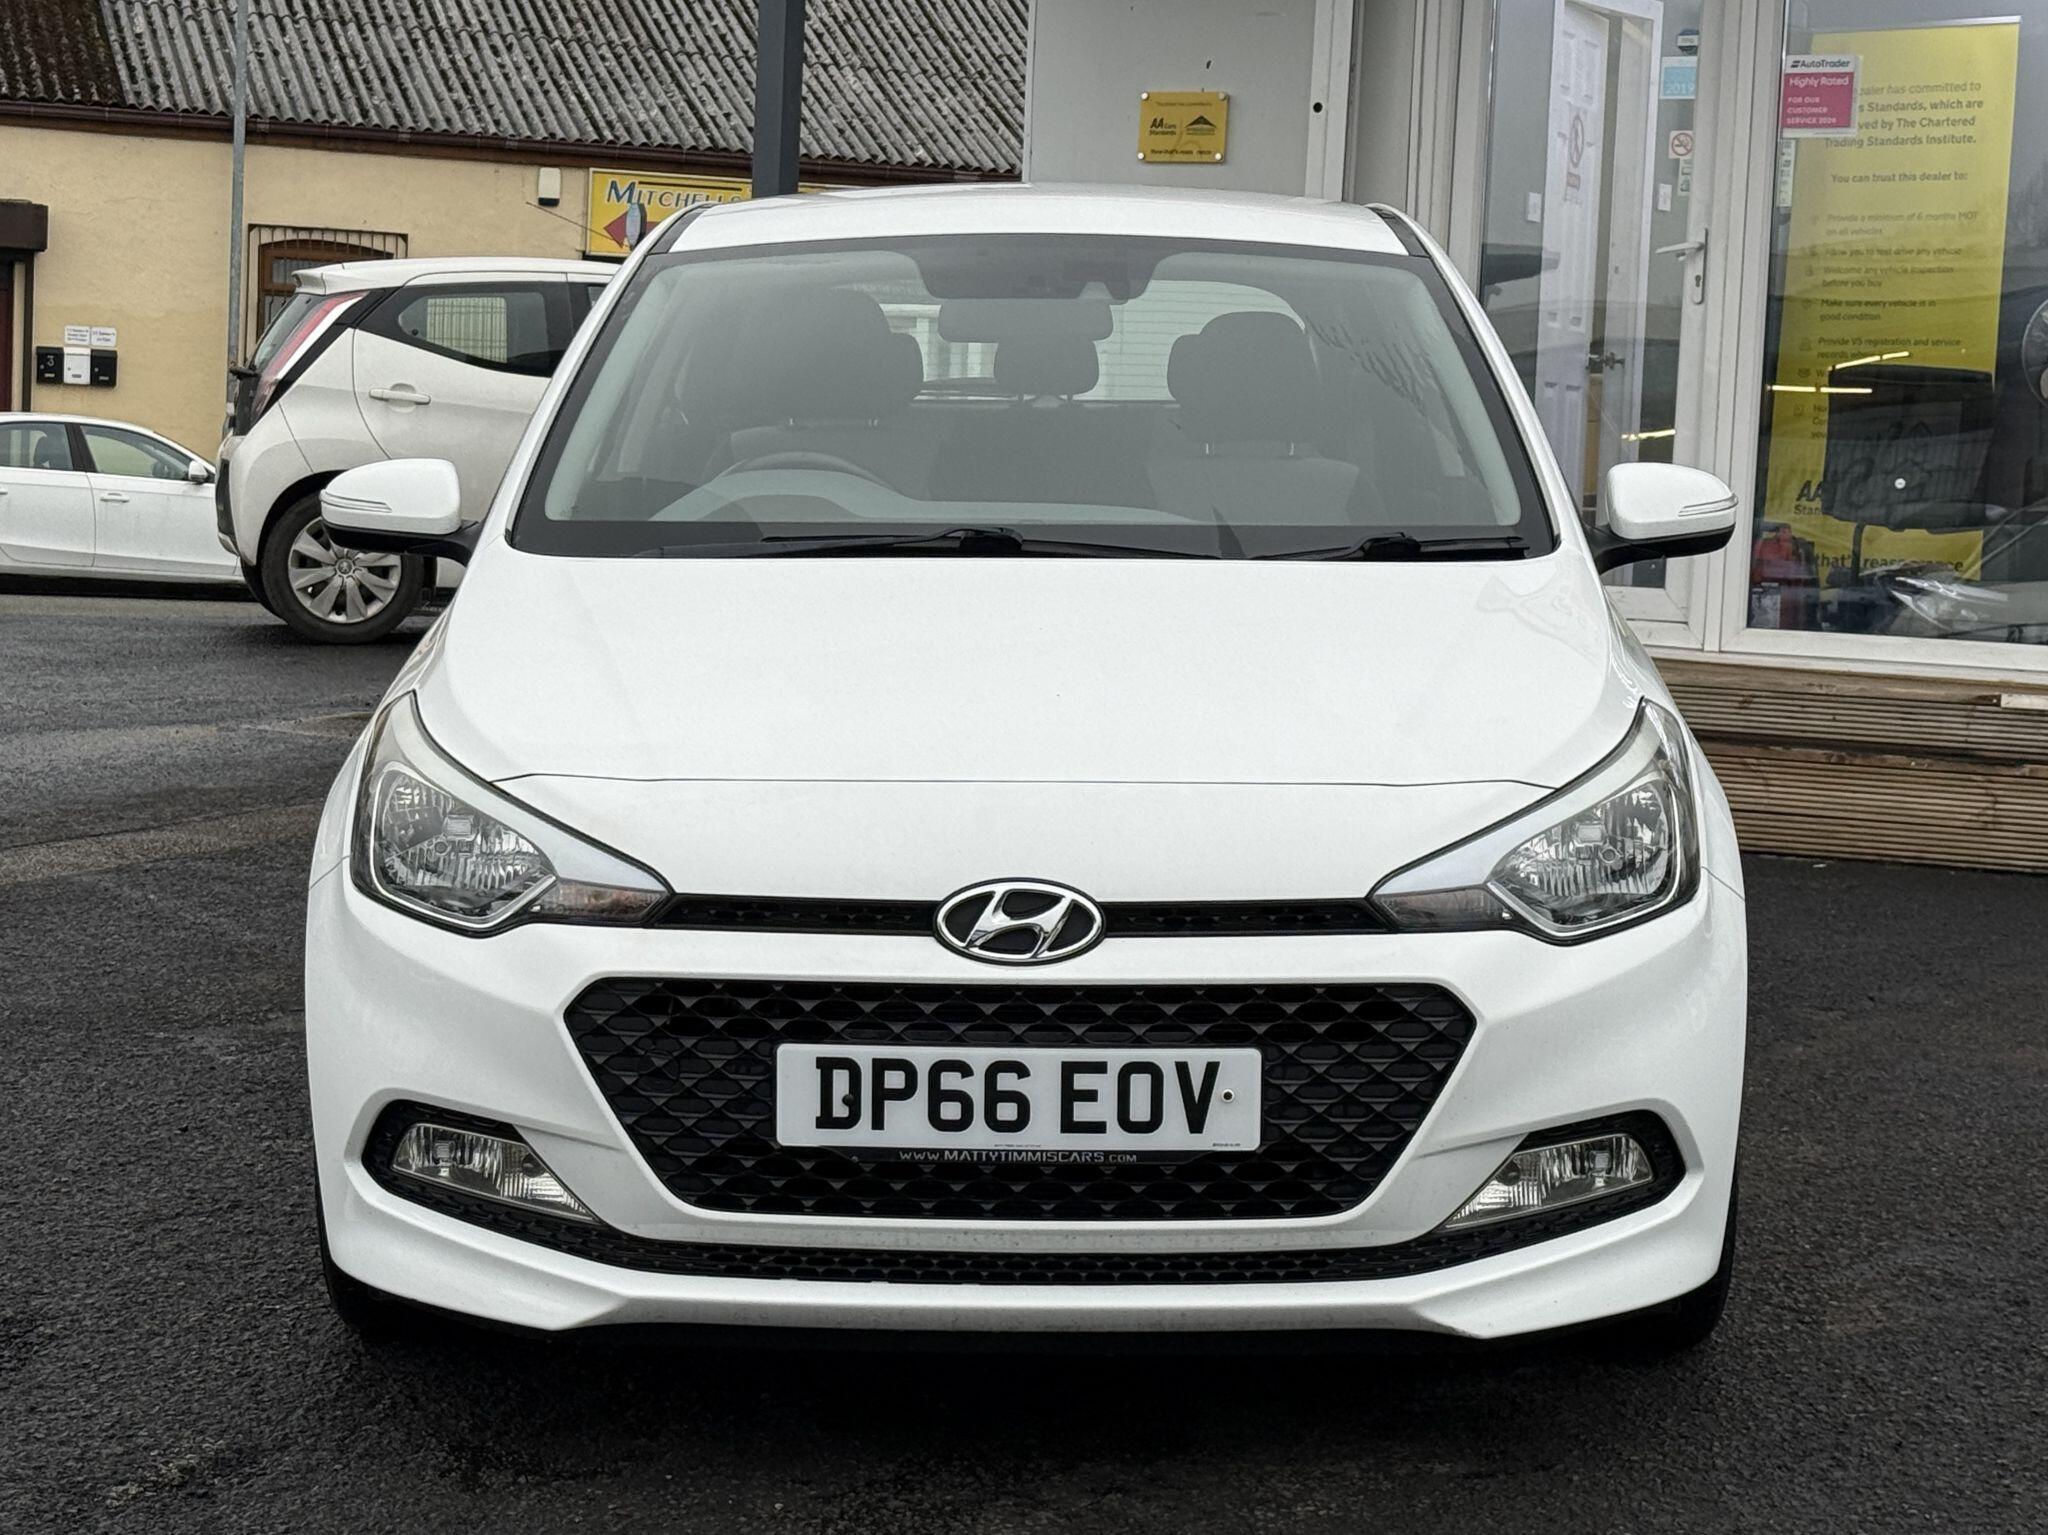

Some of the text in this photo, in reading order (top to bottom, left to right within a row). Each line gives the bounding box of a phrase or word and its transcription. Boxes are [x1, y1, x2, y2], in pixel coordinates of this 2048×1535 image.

[1789, 76, 1850, 88] Highly Rated
[1887, 84, 1905, 94] has
[1908, 81, 1969, 94] committed
[1970, 81, 1982, 92] to
[1867, 101, 1928, 113] Standards,
[1929, 99, 1964, 109] which
[1965, 100, 1984, 109] are
[1881, 119, 1894, 131] by
[1896, 118, 1917, 129] The
[1919, 115, 1977, 128] Chartered
[1825, 134, 1977, 149] Trading Standards Institute.
[1831, 174, 1851, 184] You
[1852, 175, 1871, 183] can
[1872, 173, 1899, 182] trust
[1900, 172, 1917, 182] this
[1919, 171, 1953, 182] dealer
[1958, 210, 1978, 220] MOT
[1822, 279, 1849, 287] before
[1850, 280, 1866, 288] you
[1820, 299, 1844, 307] Make
[1819, 313, 1882, 322] good condition
[1817, 337, 1850, 346] Provide
[1864, 337, 1912, 347] registration
[1913, 337, 1930, 346] and
[1931, 338, 1962, 347] service
[815, 1056, 1221, 1134] DP66 EOV
